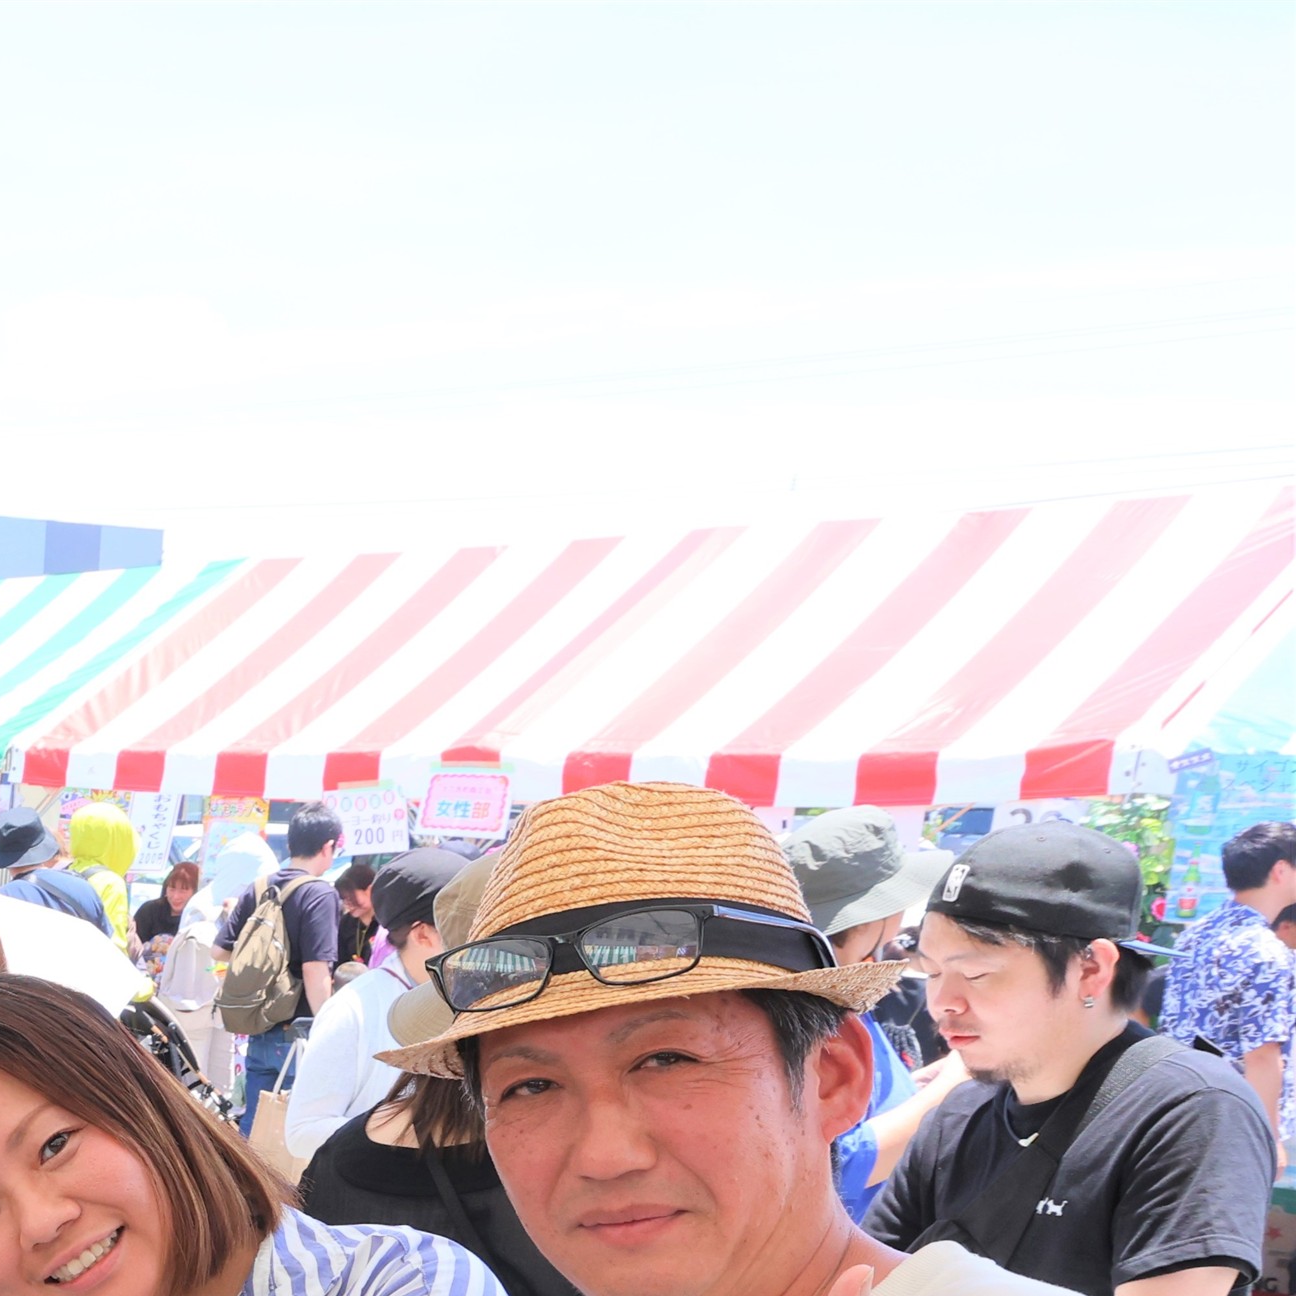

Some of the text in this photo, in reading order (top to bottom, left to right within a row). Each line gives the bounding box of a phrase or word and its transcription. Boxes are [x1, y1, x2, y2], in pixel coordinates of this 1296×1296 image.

[435, 801, 491, 819] 女性部
[354, 827, 385, 845] 200
